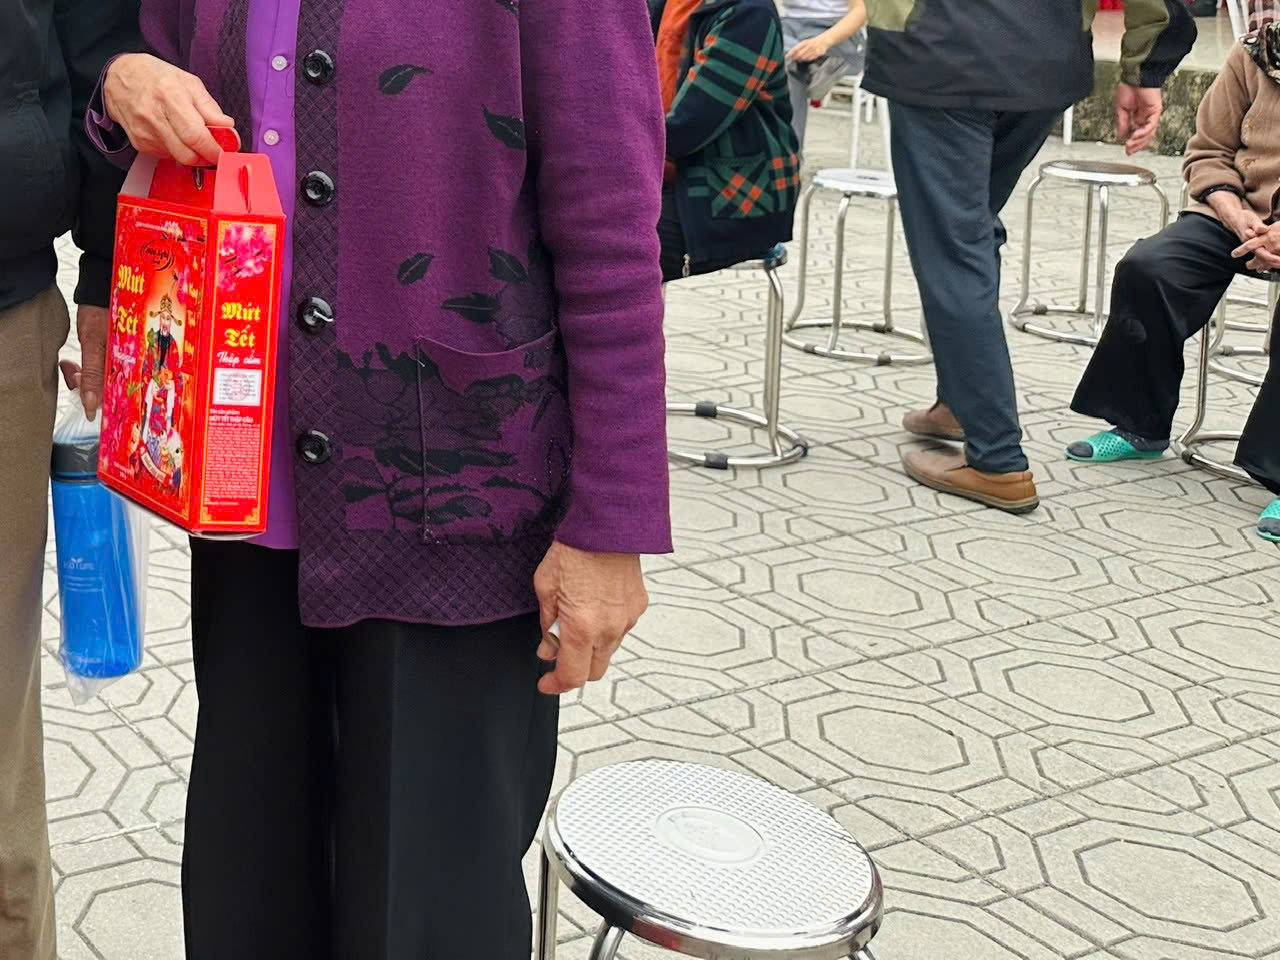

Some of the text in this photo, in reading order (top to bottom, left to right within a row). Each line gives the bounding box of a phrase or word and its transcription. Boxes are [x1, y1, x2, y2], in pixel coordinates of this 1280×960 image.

[118, 264, 145, 295] Mứt
[117, 302, 138, 335] Tết
[221, 301, 261, 321] Mứt
[224, 324, 255, 348] Tết
